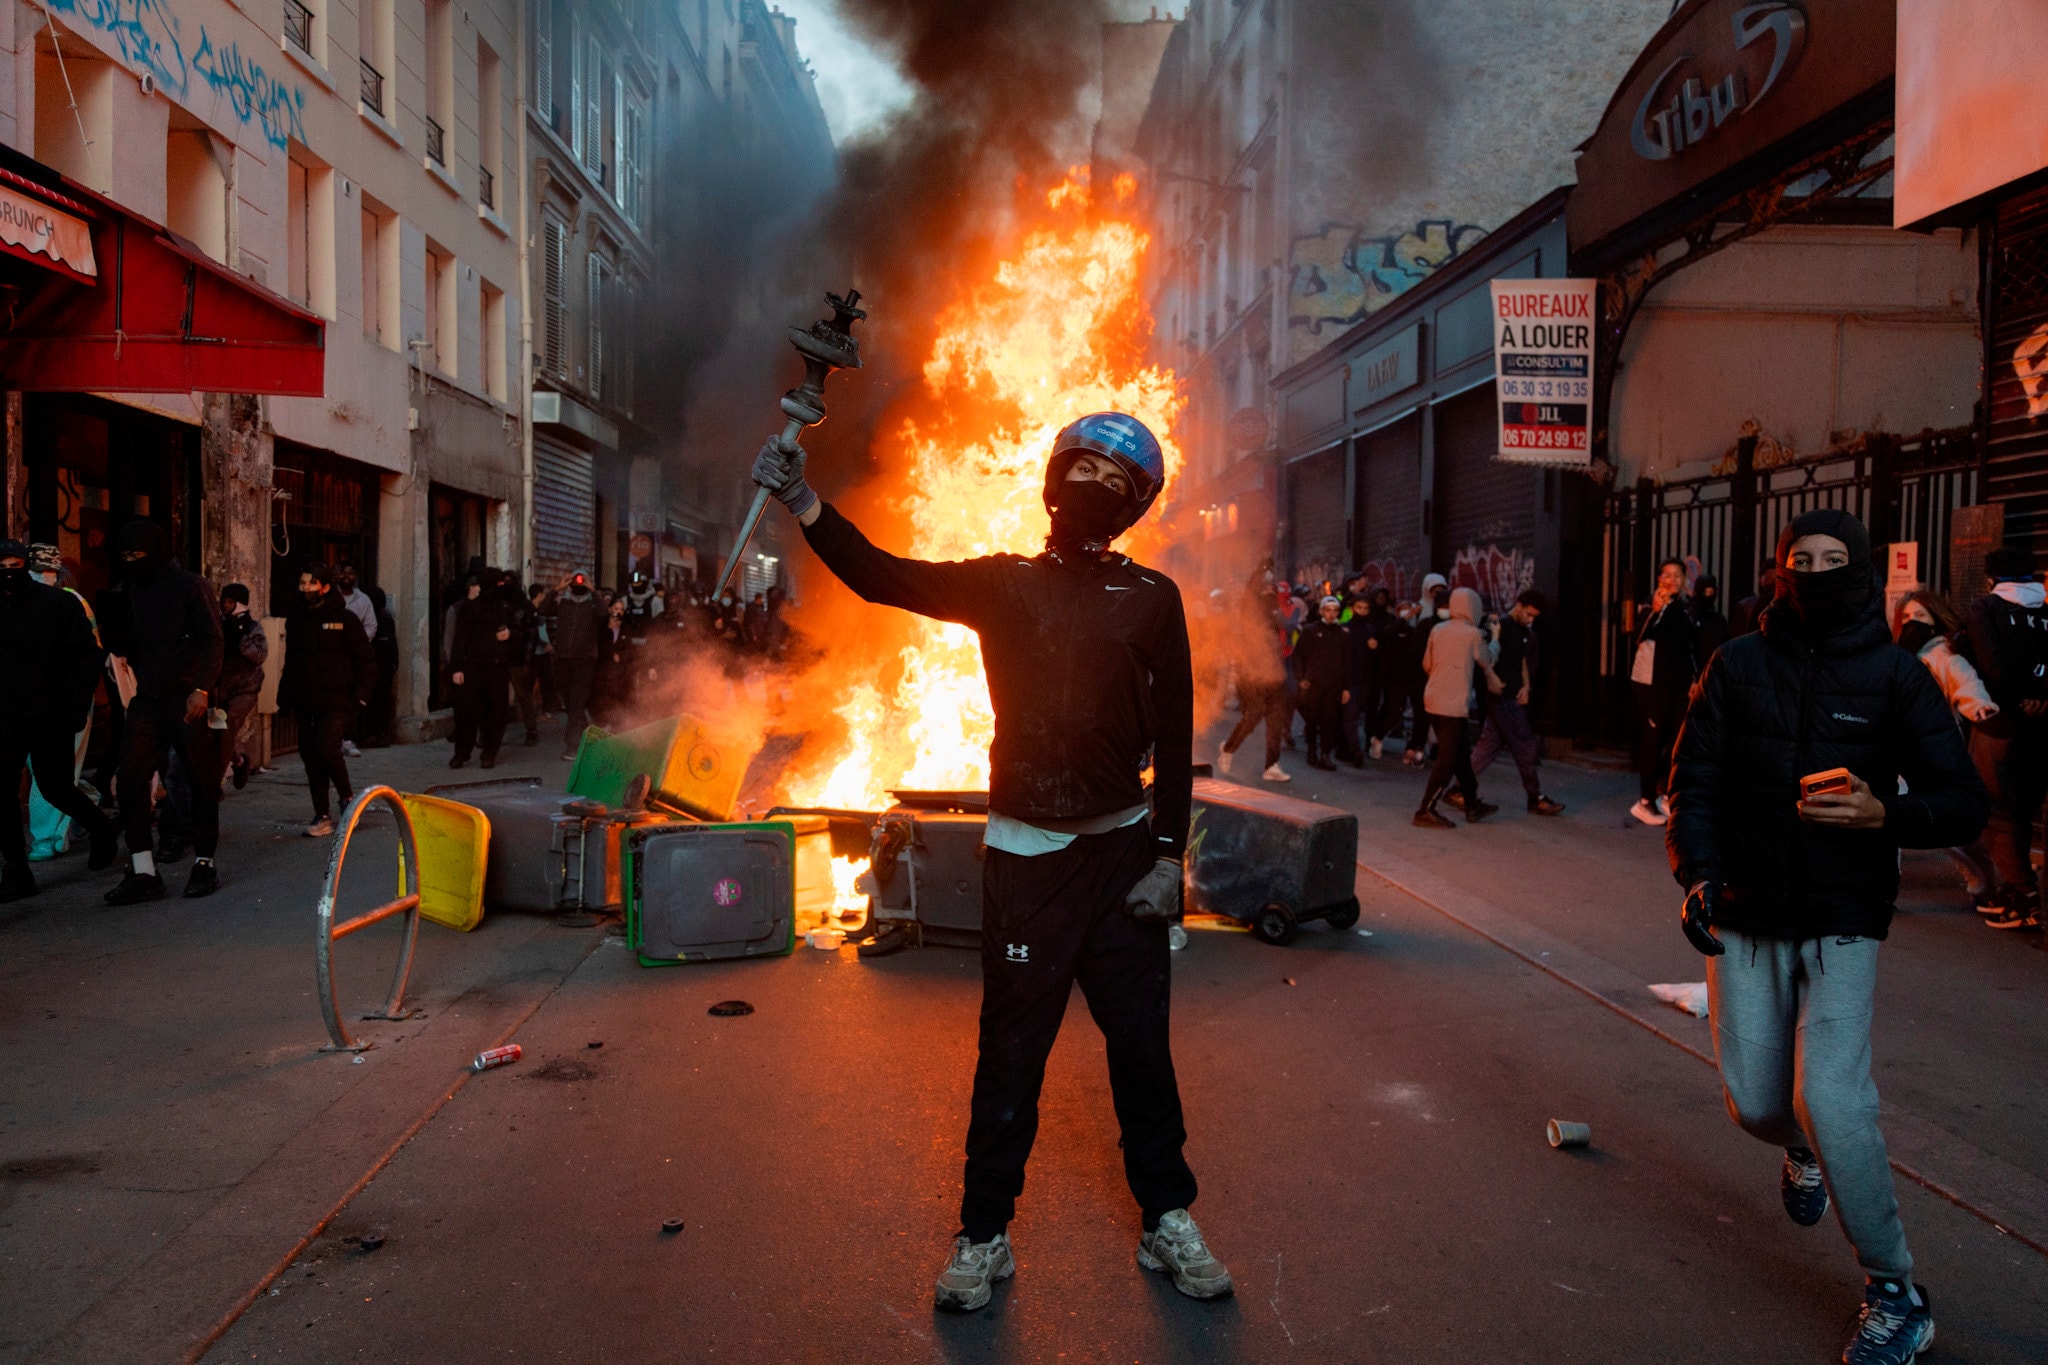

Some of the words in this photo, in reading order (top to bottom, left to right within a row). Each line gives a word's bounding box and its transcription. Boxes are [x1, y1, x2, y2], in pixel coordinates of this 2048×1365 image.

[1498, 294, 1589, 319] BUREAUX
[1501, 319, 1516, 348] À
[1522, 325, 1589, 349] LOUER
[1503, 380, 1518, 395] 06
[1521, 380, 1535, 396] 30
[1538, 381, 1553, 397] 32
[1557, 381, 1571, 397] 19
[1573, 382, 1588, 397] 35
[1538, 406, 1562, 422] JLL
[1097, 428, 1124, 443] cooltra
[1504, 429, 1519, 446] 06
[1521, 429, 1536, 446] 70
[1537, 430, 1553, 447] 24
[1554, 431, 1570, 447] 99
[1571, 431, 1586, 448] 12
